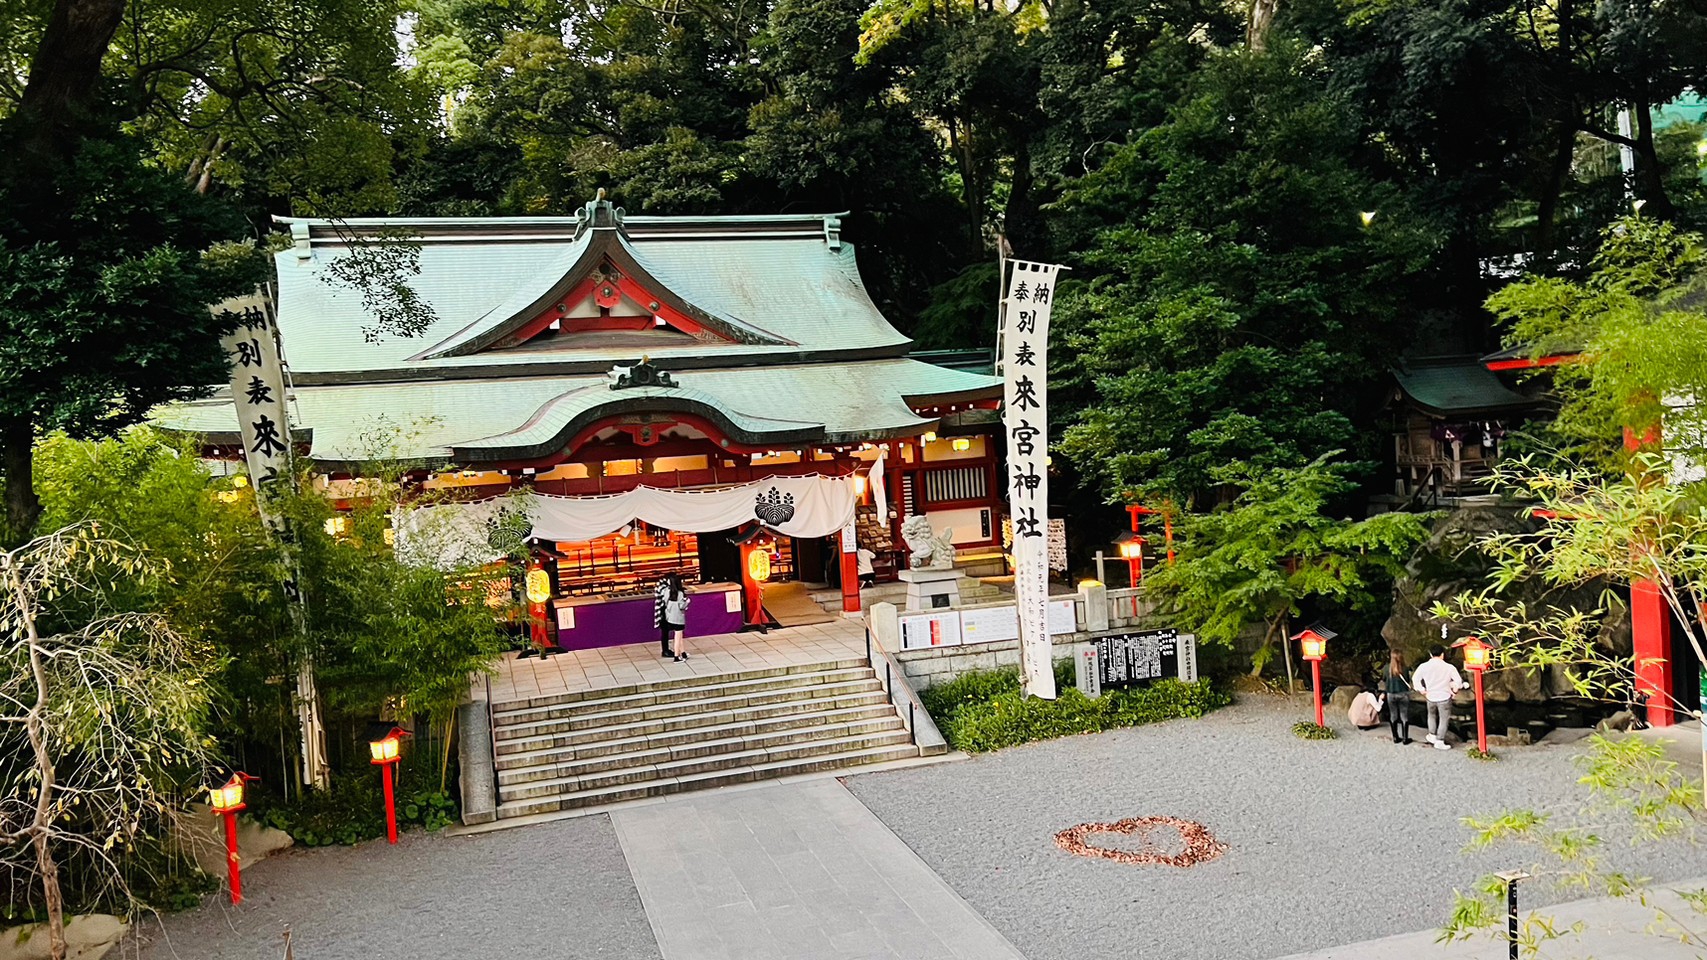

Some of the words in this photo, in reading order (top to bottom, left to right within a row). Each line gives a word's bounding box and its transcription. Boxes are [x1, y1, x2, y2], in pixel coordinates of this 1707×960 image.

[1013, 280, 1050, 305] 奉納
[1011, 309, 1042, 538] 別表來宮神社
